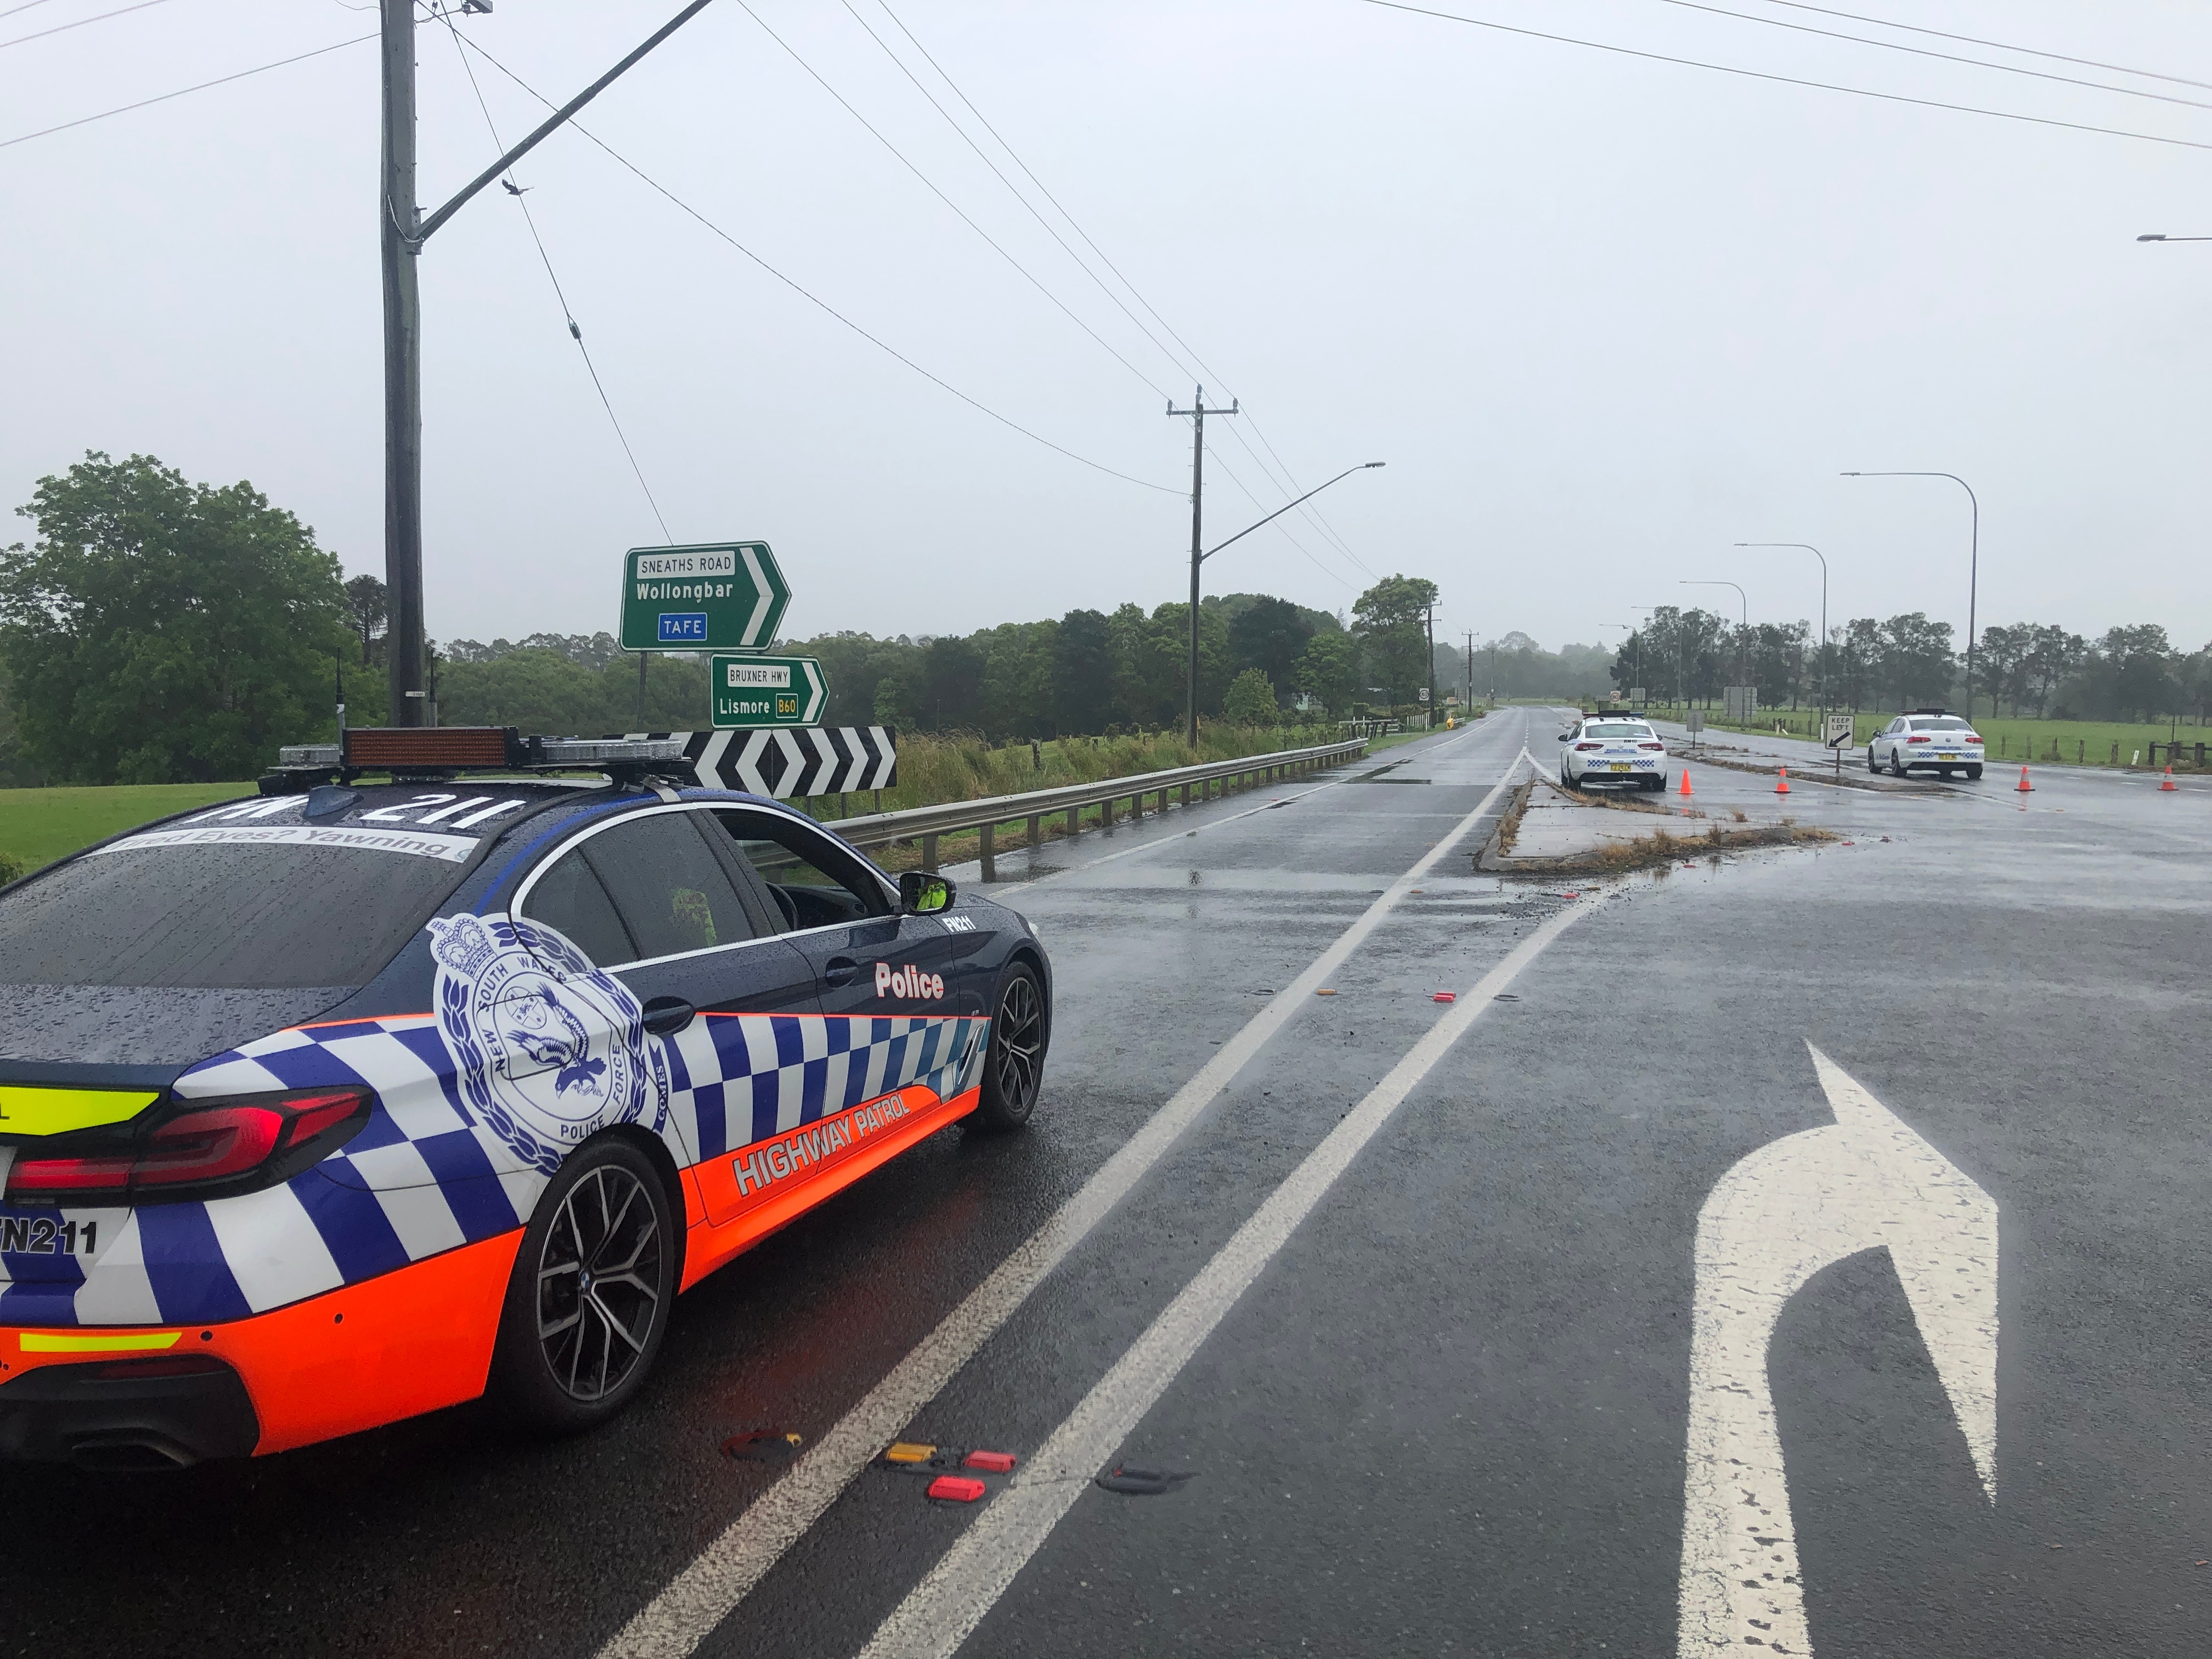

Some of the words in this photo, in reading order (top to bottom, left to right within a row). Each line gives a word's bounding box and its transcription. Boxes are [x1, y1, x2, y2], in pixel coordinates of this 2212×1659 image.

[641, 558, 693, 573] SNEATHS
[700, 556, 731, 571] ROAD
[636, 581, 733, 603] Wollongbar
[664, 620, 702, 634] TAFE
[730, 669, 768, 682] BRUXNER
[771, 671, 788, 682] HWY
[720, 698, 770, 714] Lismore
[778, 699, 795, 713] B60
[358, 794, 527, 829] 211
[191, 830, 296, 843] Eyes?
[304, 830, 452, 856] Yawning
[942, 915, 976, 933] FN211
[516, 956, 567, 981] WALES
[875, 962, 944, 1000] Police
[478, 963, 509, 1013] SOUTH
[482, 1029, 506, 1073] NEW
[561, 1114, 605, 1139] POLICE
[612, 1044, 624, 1105] FORCE
[732, 1116, 853, 1196] HIGHWAY
[853, 1092, 910, 1138] PATROL
[0, 1217, 98, 1255] N211
